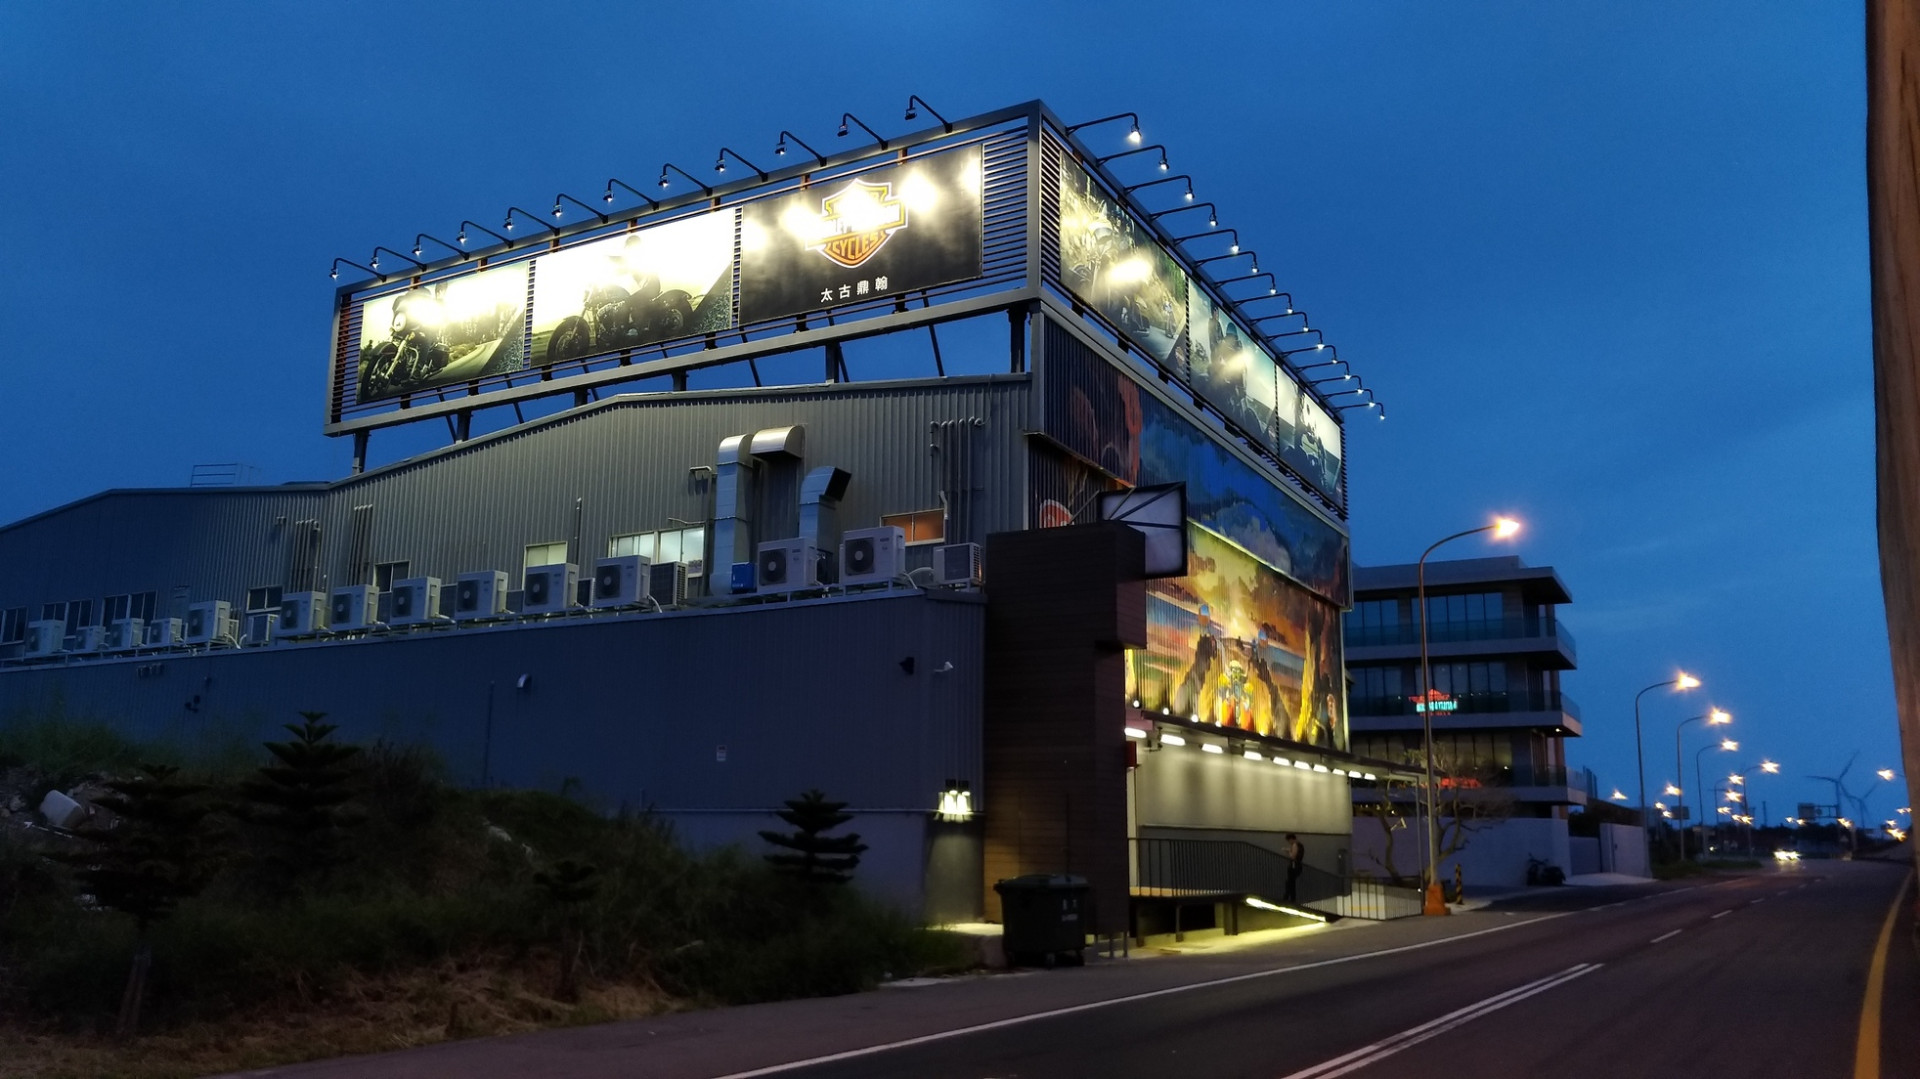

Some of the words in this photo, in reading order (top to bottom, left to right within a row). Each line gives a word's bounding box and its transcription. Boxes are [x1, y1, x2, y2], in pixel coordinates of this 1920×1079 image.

[833, 232, 879, 260] CYCLES
[820, 275, 888, 303] 太古鼎翰
